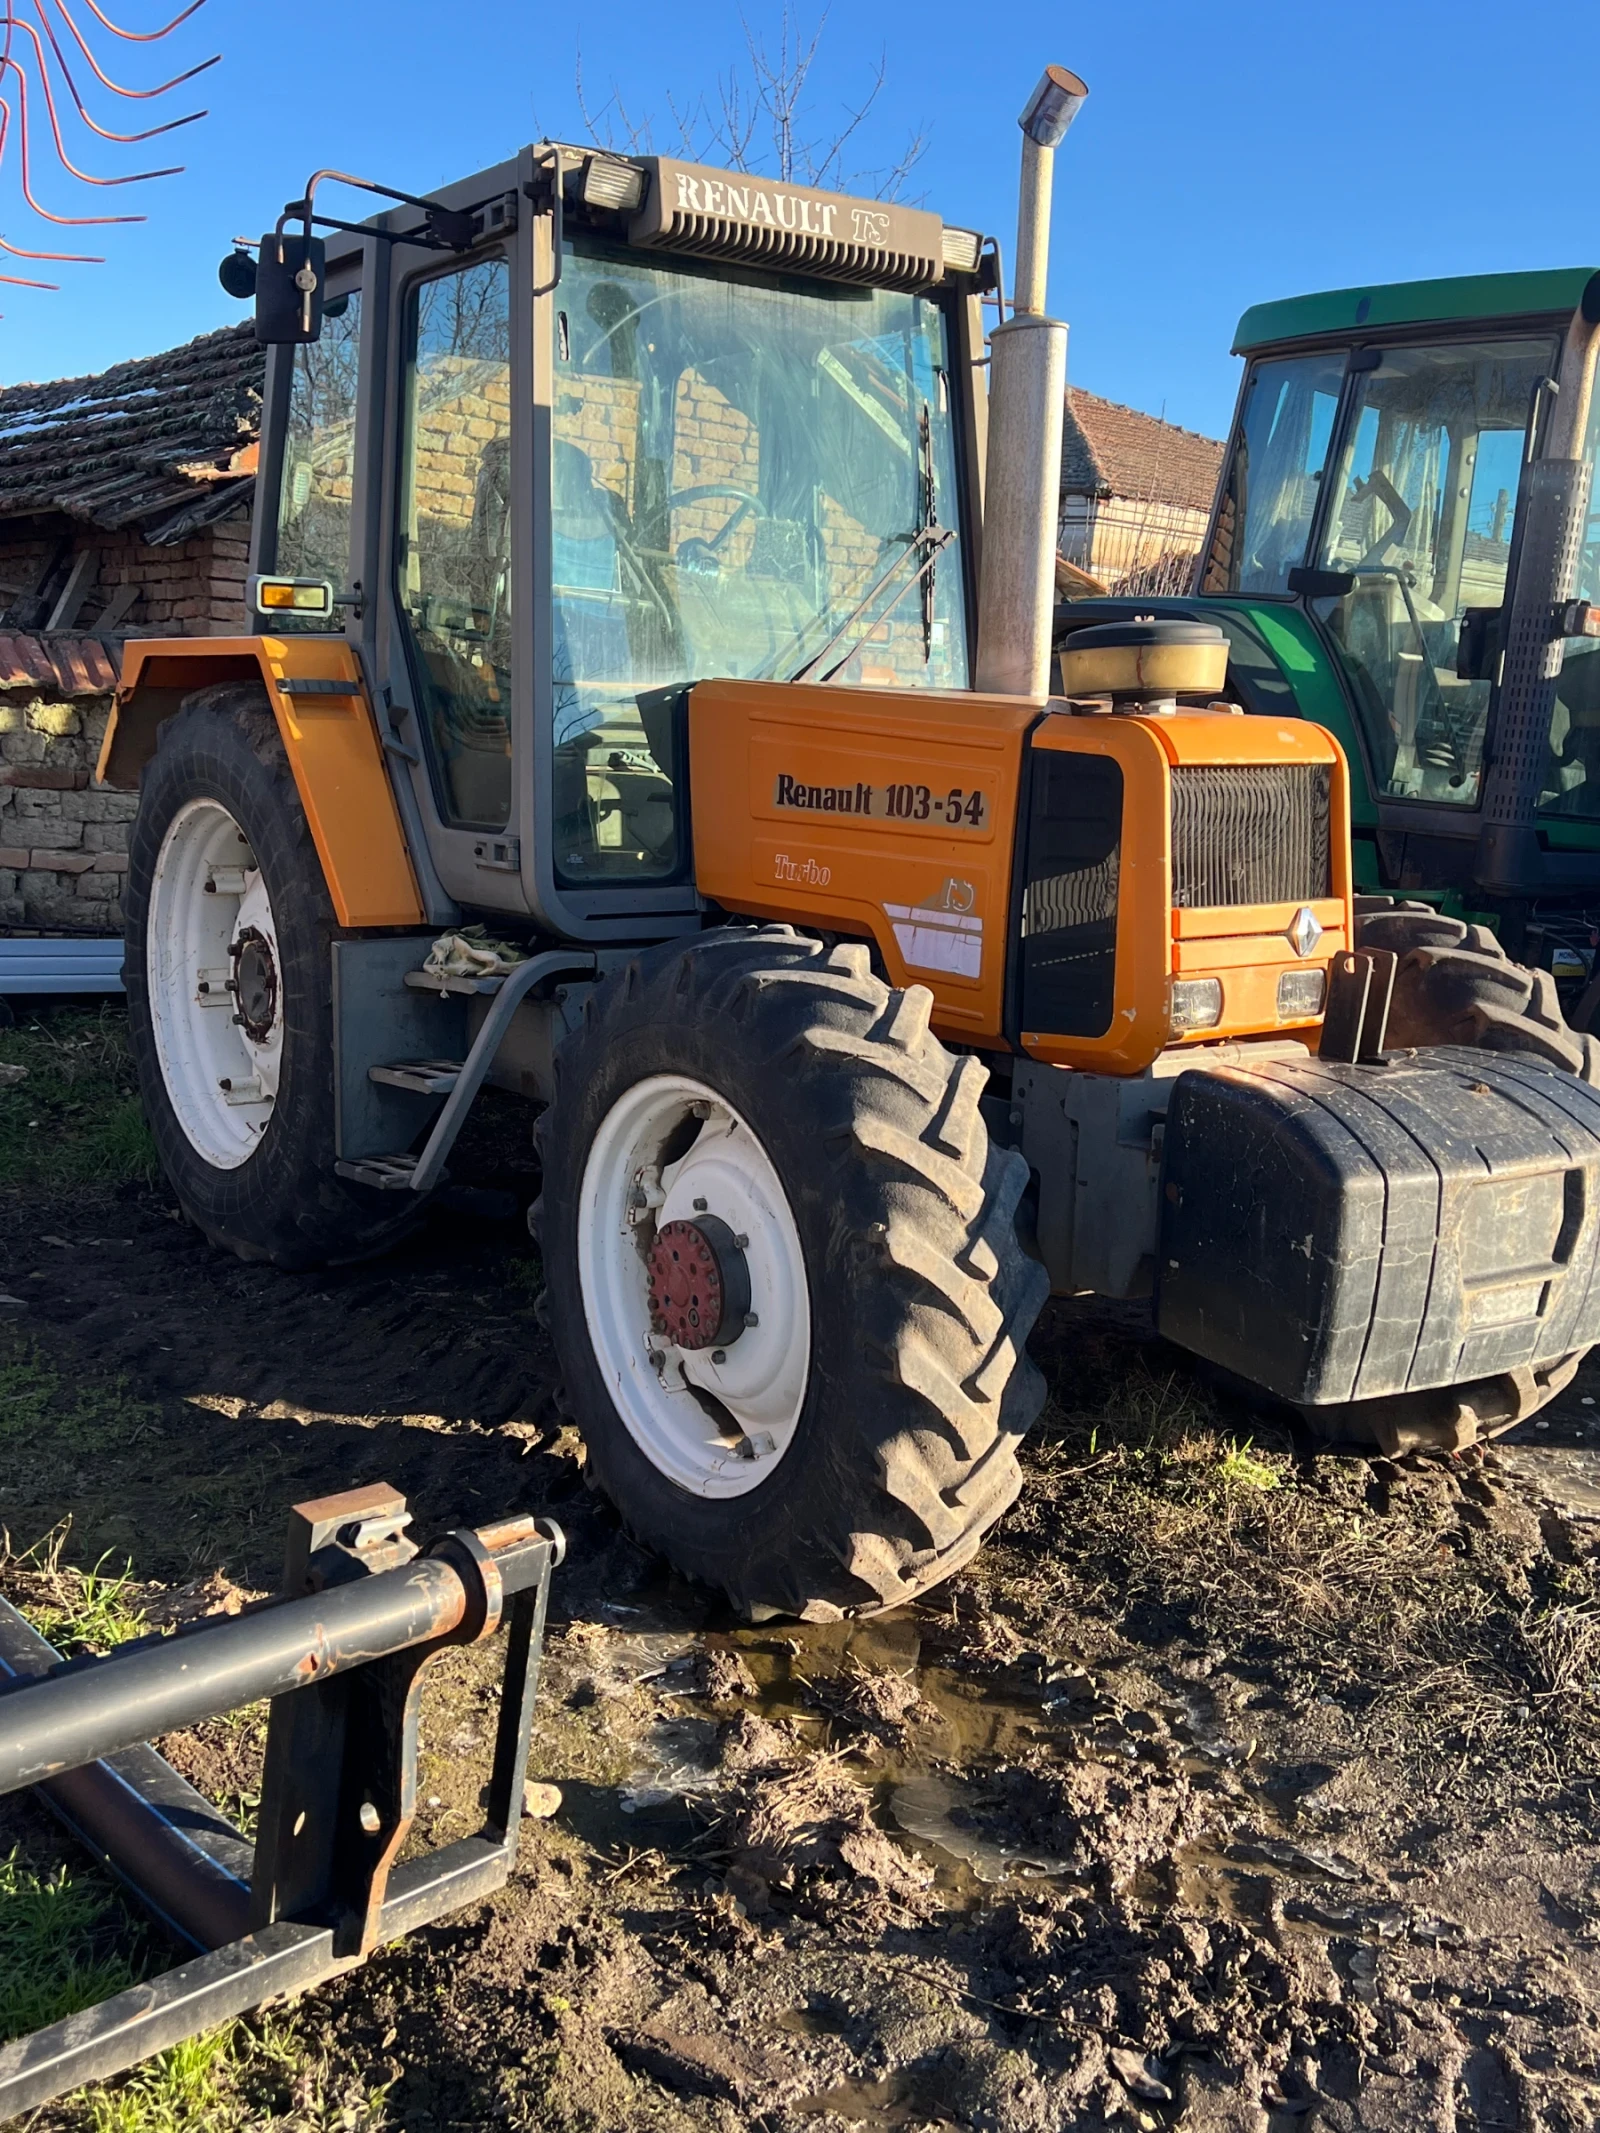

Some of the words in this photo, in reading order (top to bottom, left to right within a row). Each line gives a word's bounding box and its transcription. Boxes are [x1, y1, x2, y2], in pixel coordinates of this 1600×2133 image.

[675, 172, 837, 237] RENAULT
[851, 208, 890, 245] TS
[776, 773, 873, 815] Renault
[885, 784, 984, 826] 103-54
[774, 853, 831, 886] Turbo
